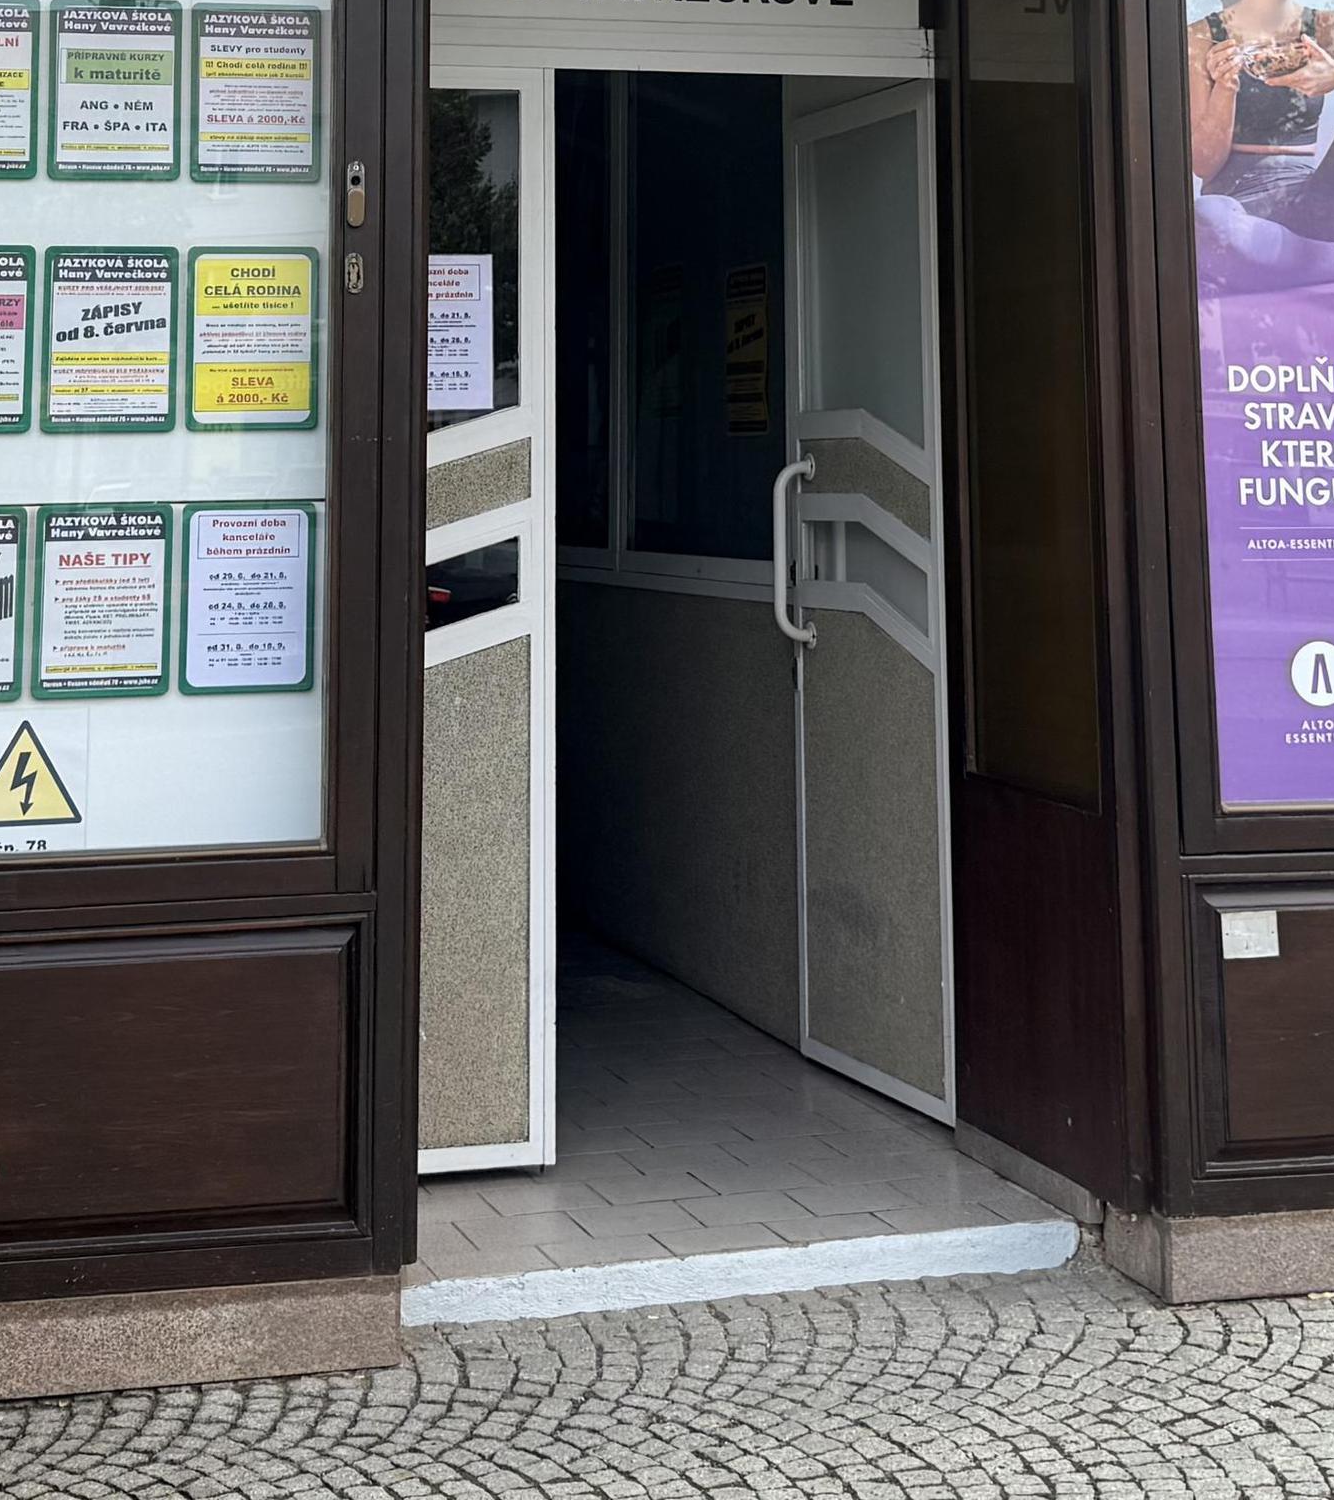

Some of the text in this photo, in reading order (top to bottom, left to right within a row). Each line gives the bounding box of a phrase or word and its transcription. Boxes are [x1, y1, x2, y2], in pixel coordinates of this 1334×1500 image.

[210, 45, 243, 53] SLEVY
[67, 50, 165, 61] PŘÍPRAVNÉ KURZY
[74, 68, 161, 81] k maturitě
[80, 100, 153, 111] ANG NĚM
[63, 120, 167, 132] FRA ŠPA ITA
[230, 265, 276, 278] CHODÍ
[204, 283, 301, 295] CELÁ RODINA
[231, 377, 274, 387] SLEVA
[212, 518, 286, 528] Provozní doba
[59, 552, 151, 566] NAŠE TIPY
